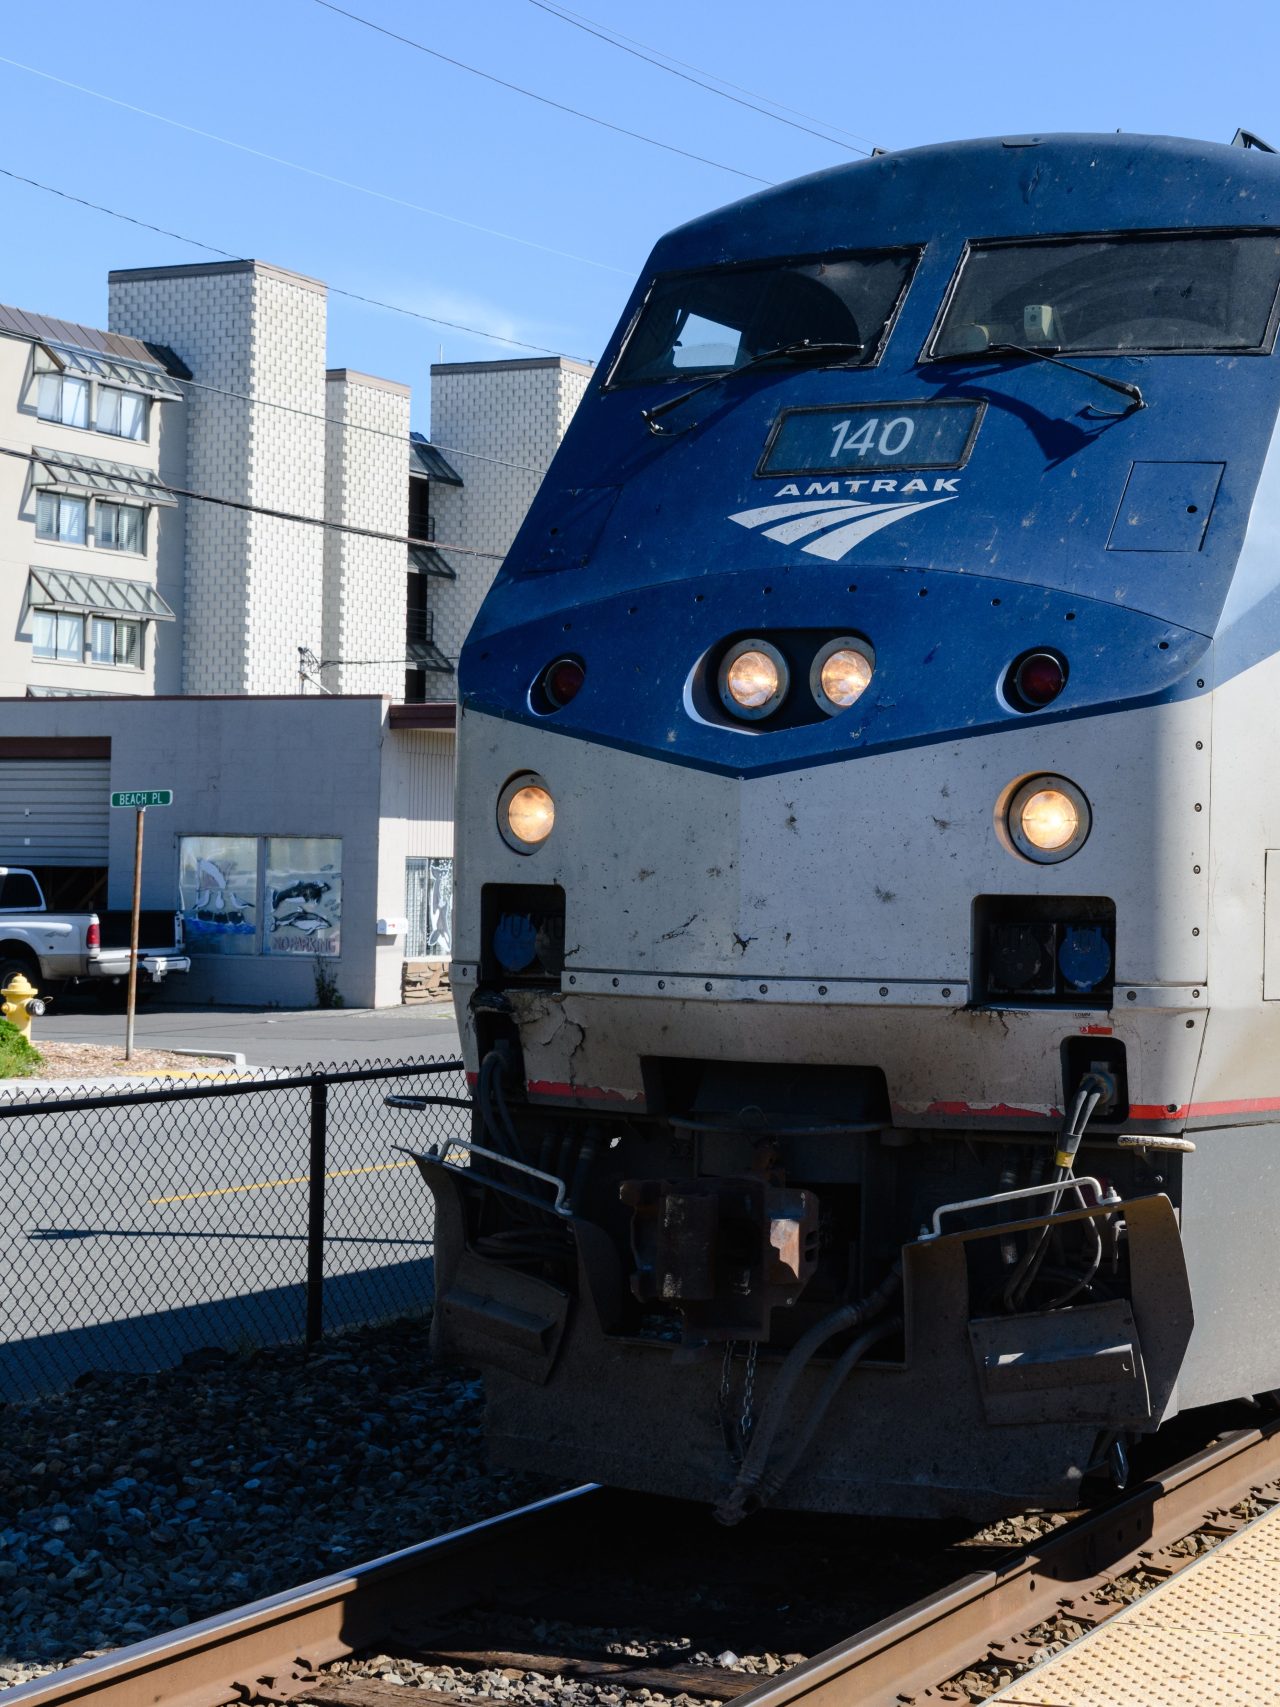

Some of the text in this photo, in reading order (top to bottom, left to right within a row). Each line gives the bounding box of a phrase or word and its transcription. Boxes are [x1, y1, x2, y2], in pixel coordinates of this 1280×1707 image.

[830, 417, 915, 458] 140
[774, 478, 961, 497] AMTRAK
[120, 792, 163, 805] BEACH PL
